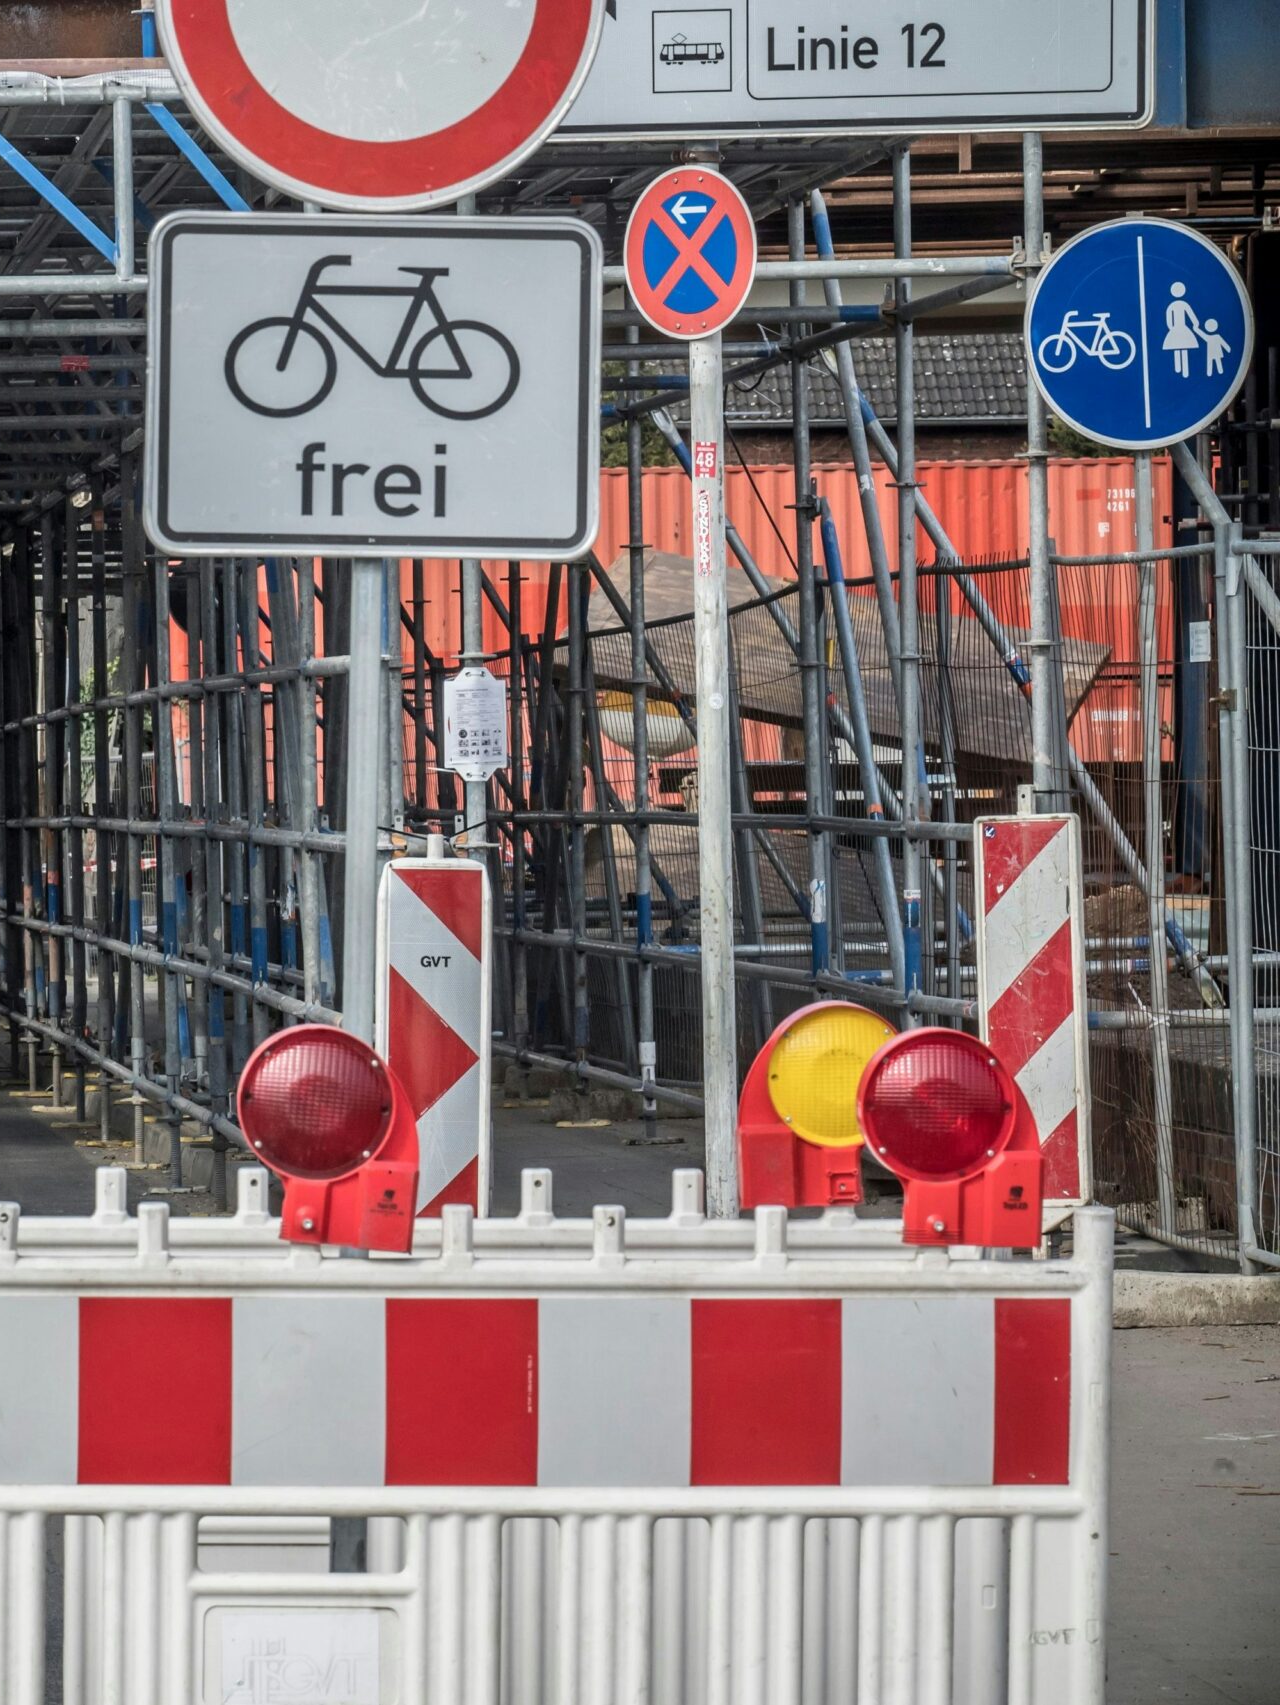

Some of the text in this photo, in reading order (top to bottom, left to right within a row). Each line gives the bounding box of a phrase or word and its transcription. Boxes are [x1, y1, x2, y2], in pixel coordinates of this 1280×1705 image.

[767, 22, 946, 71] Linie 12
[696, 452, 714, 467] 48
[295, 442, 447, 518] frei
[420, 955, 452, 968] GVT
